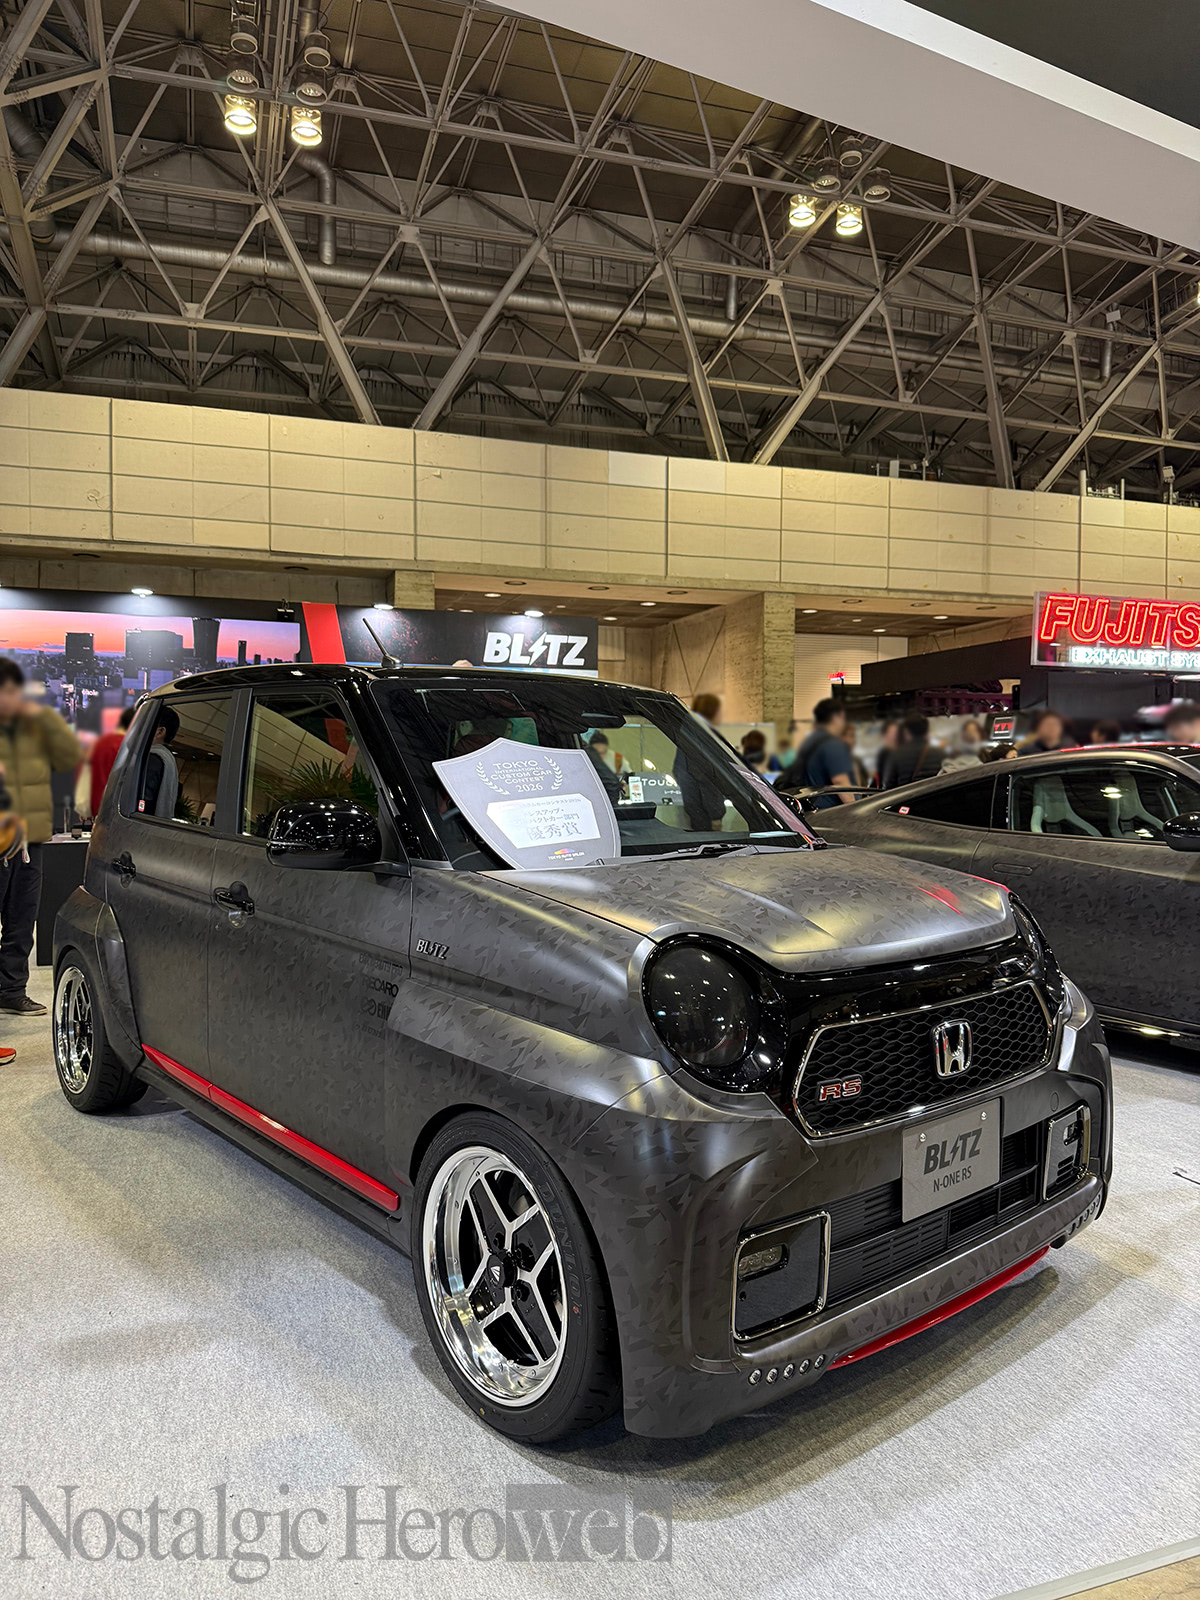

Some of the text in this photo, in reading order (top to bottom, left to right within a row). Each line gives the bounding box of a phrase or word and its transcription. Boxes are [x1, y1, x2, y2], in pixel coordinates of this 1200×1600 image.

[1040, 594, 1200, 649] FUJITS
[483, 632, 588, 666] BLITZ
[1071, 646, 1169, 666] EXHAUST
[493, 760, 538, 769] TOKYO
[495, 766, 543, 774] INTERNATIONAL
[491, 772, 531, 780] CUSTOM
[505, 776, 545, 784] CONTEST
[515, 783, 543, 792] 2026
[527, 821, 583, 841] 優秀賞
[416, 939, 450, 960] BLITZ
[362, 975, 399, 998] RECARO
[819, 1079, 861, 1101] RS
[924, 1128, 982, 1175] BLITZ
[933, 1166, 972, 1193] N-ONE RS
